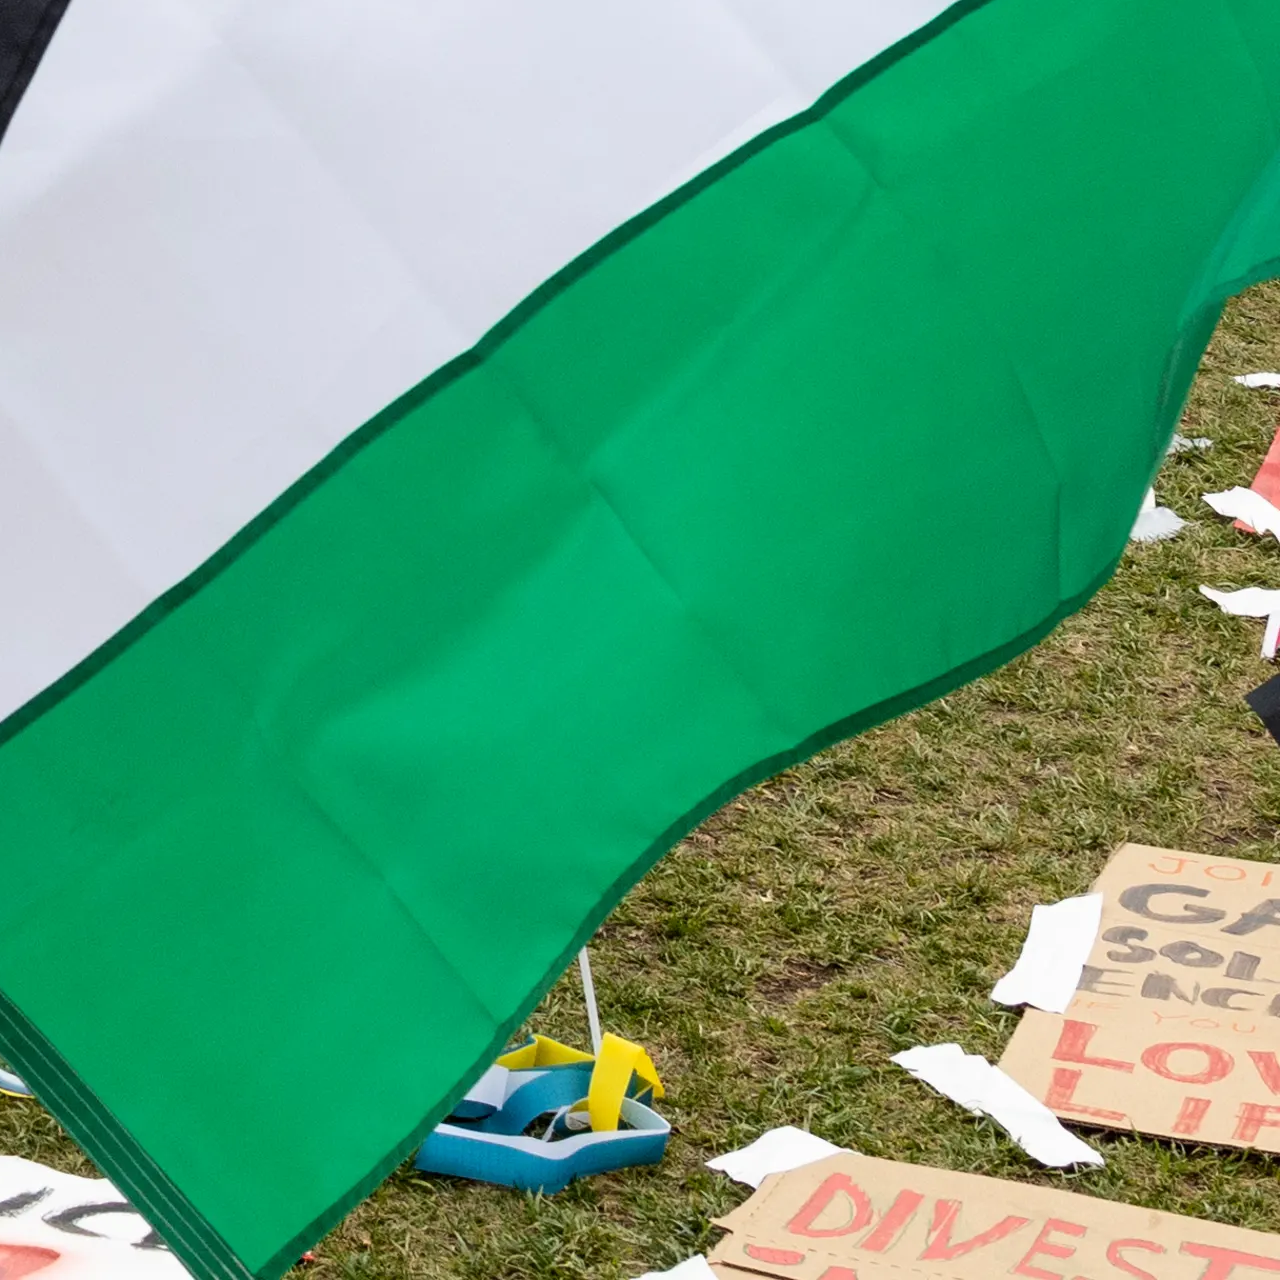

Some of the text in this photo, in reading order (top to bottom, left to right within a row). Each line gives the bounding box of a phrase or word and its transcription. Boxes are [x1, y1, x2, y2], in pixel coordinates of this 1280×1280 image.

[1148, 855, 1276, 888] JOI
[1152, 1011, 1258, 1035] YOU
[1051, 1019, 1280, 1096] LOV
[787, 1171, 1280, 1280] DIVEST
